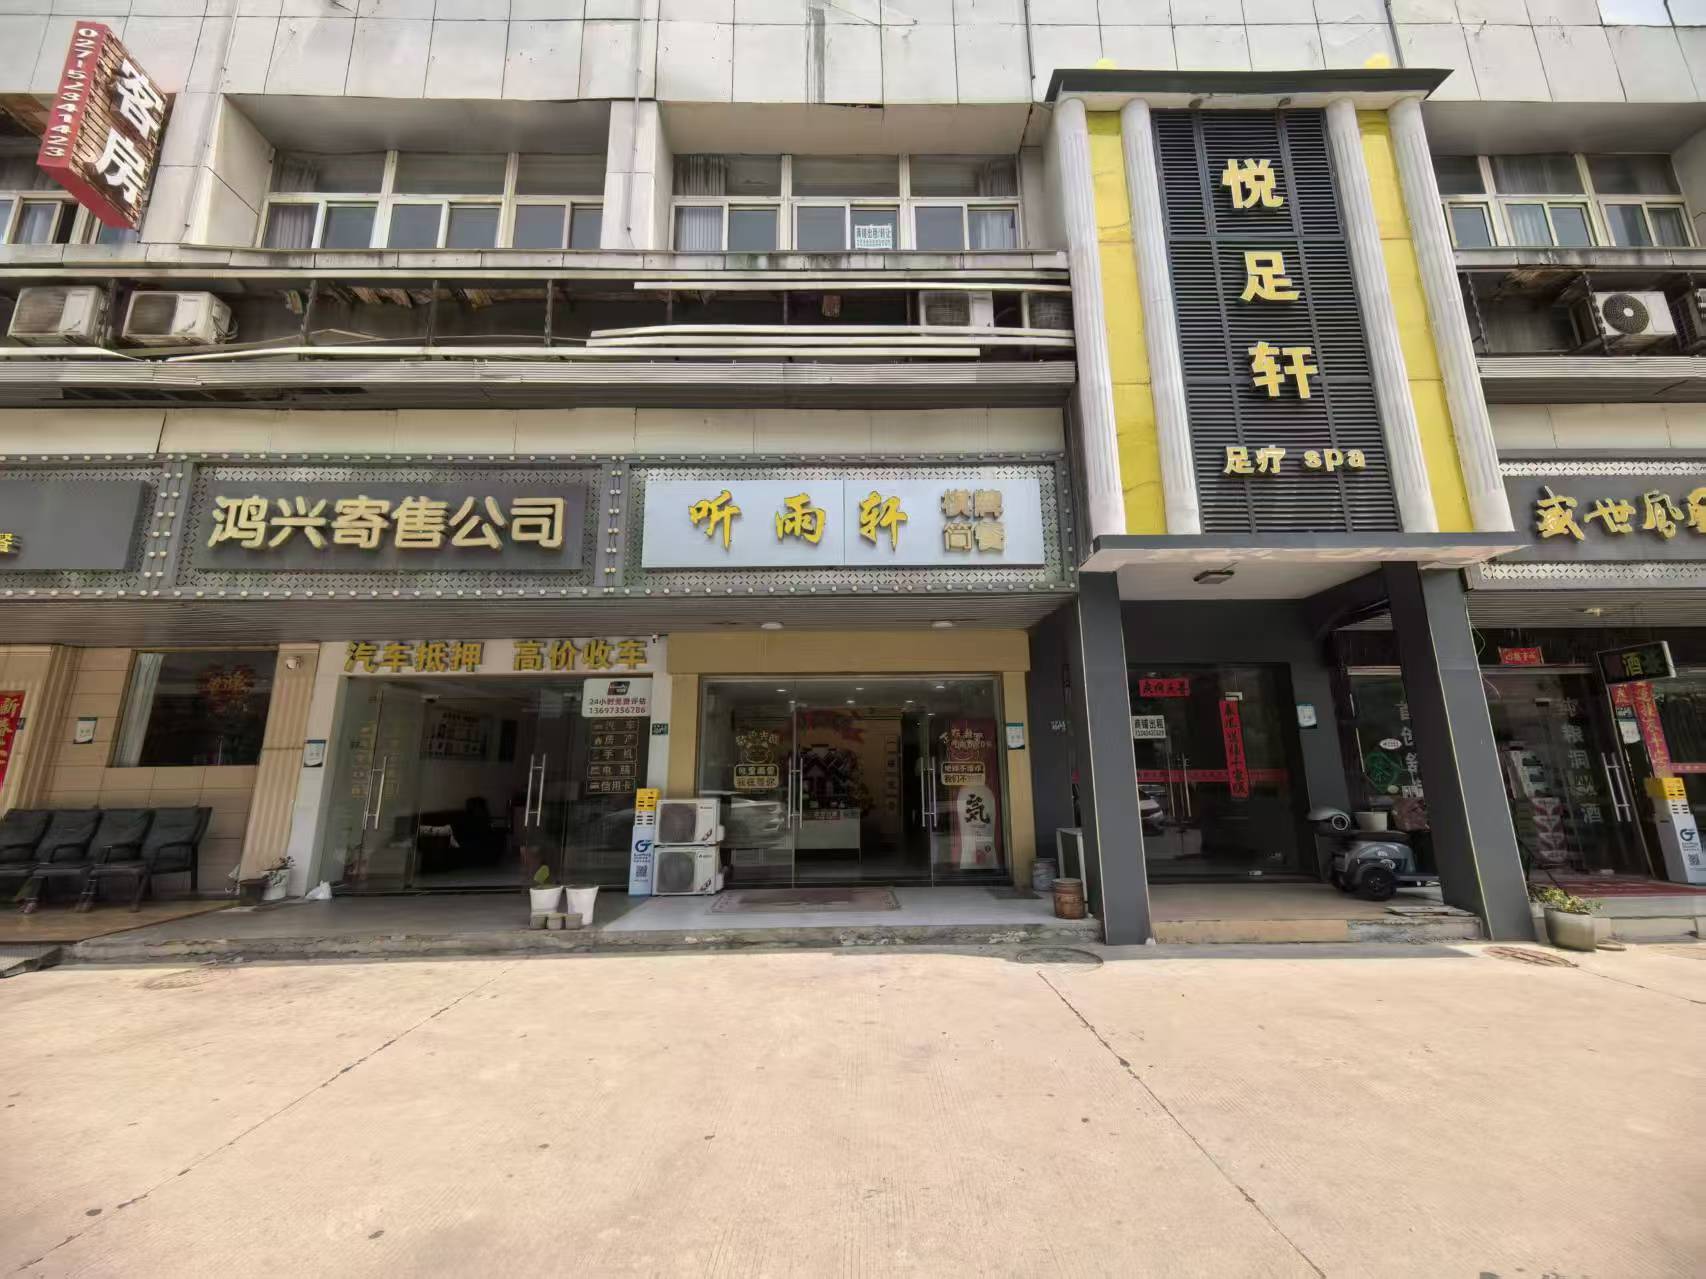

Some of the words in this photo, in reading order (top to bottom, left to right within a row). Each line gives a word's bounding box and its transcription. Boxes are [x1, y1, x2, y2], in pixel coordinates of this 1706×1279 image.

[95, 57, 165, 204] 客房
[1221, 157, 1319, 399] 悦足轩
[1222, 445, 1287, 475] 足疗
[1303, 447, 1367, 474] spa
[206, 494, 568, 551] 鸿兴寄售公司
[687, 490, 910, 554] 听雨轩
[343, 639, 485, 673] 汽车抵押
[512, 638, 649, 672] 高价收车
[601, 780, 632, 792] 信用卡
